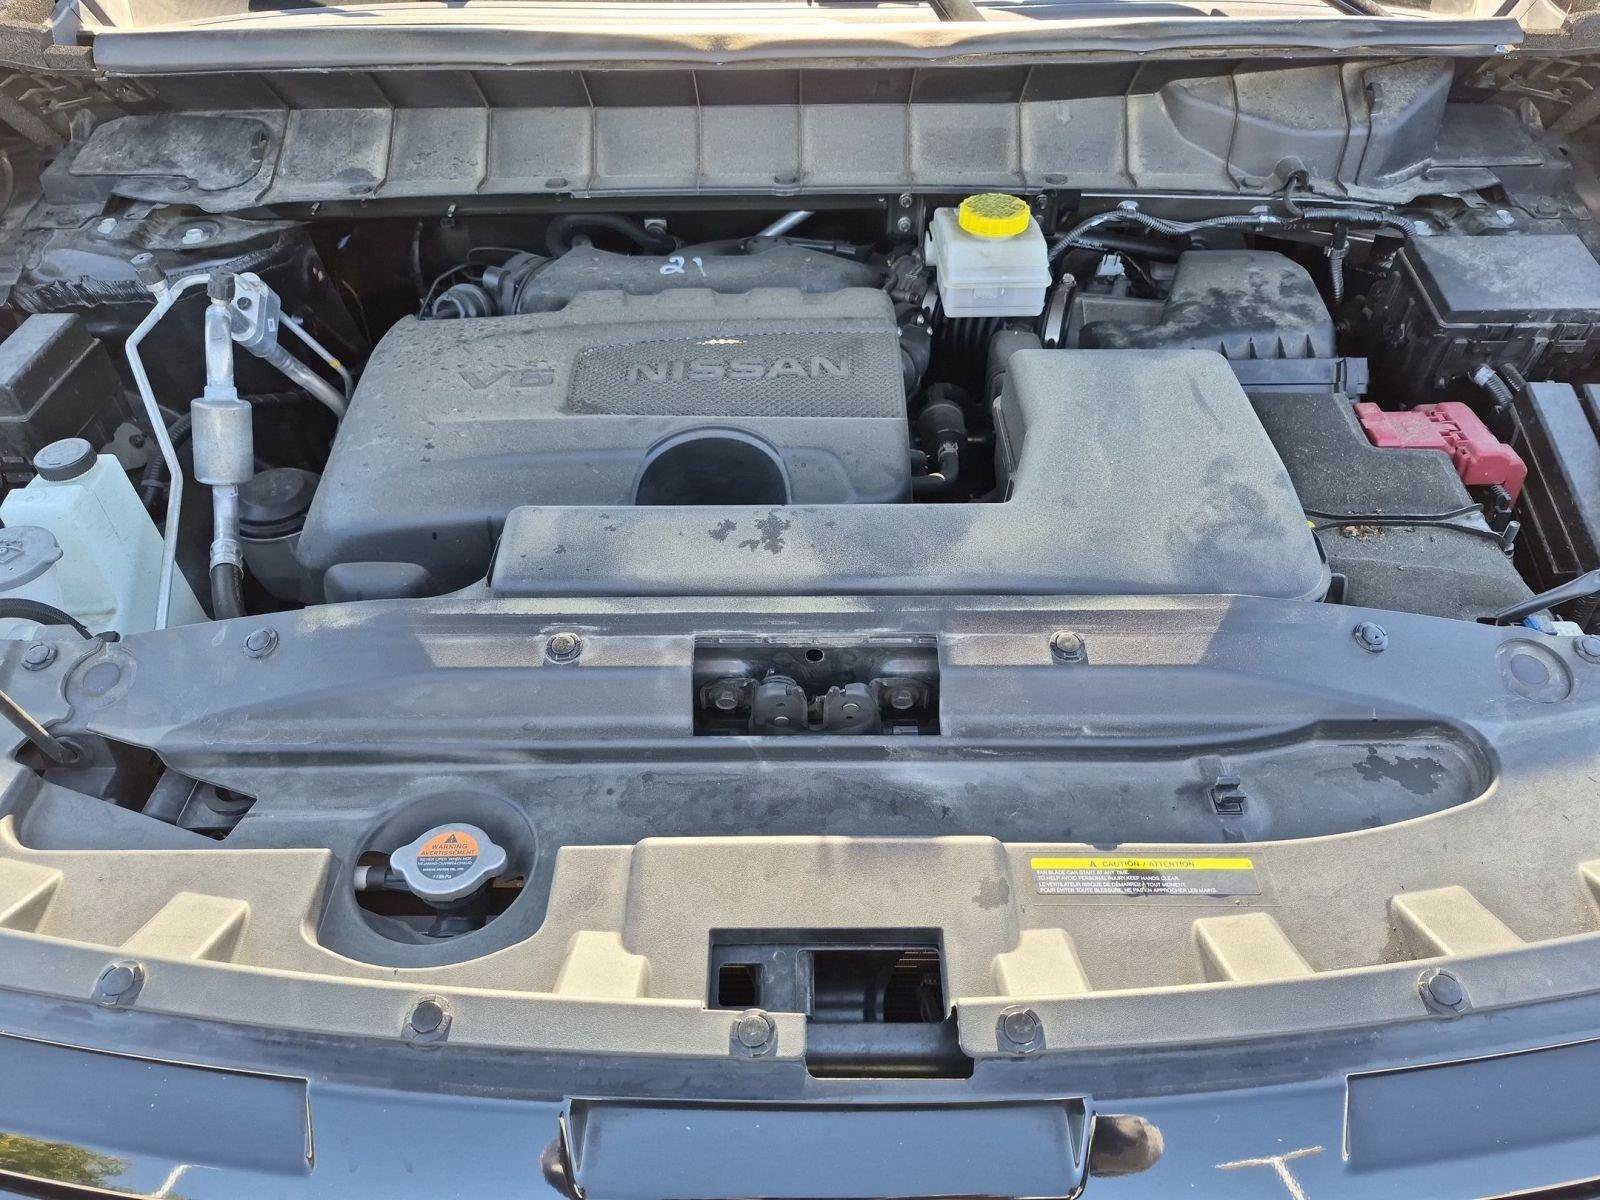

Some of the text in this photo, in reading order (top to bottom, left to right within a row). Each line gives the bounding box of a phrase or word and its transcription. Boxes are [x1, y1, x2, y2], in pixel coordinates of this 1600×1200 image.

[659, 255, 707, 277] 21
[458, 365, 554, 390] V6
[628, 355, 851, 386] NISSAN
[1102, 860, 1140, 868] CAUTION
[1148, 860, 1195, 868] ATTENTION
